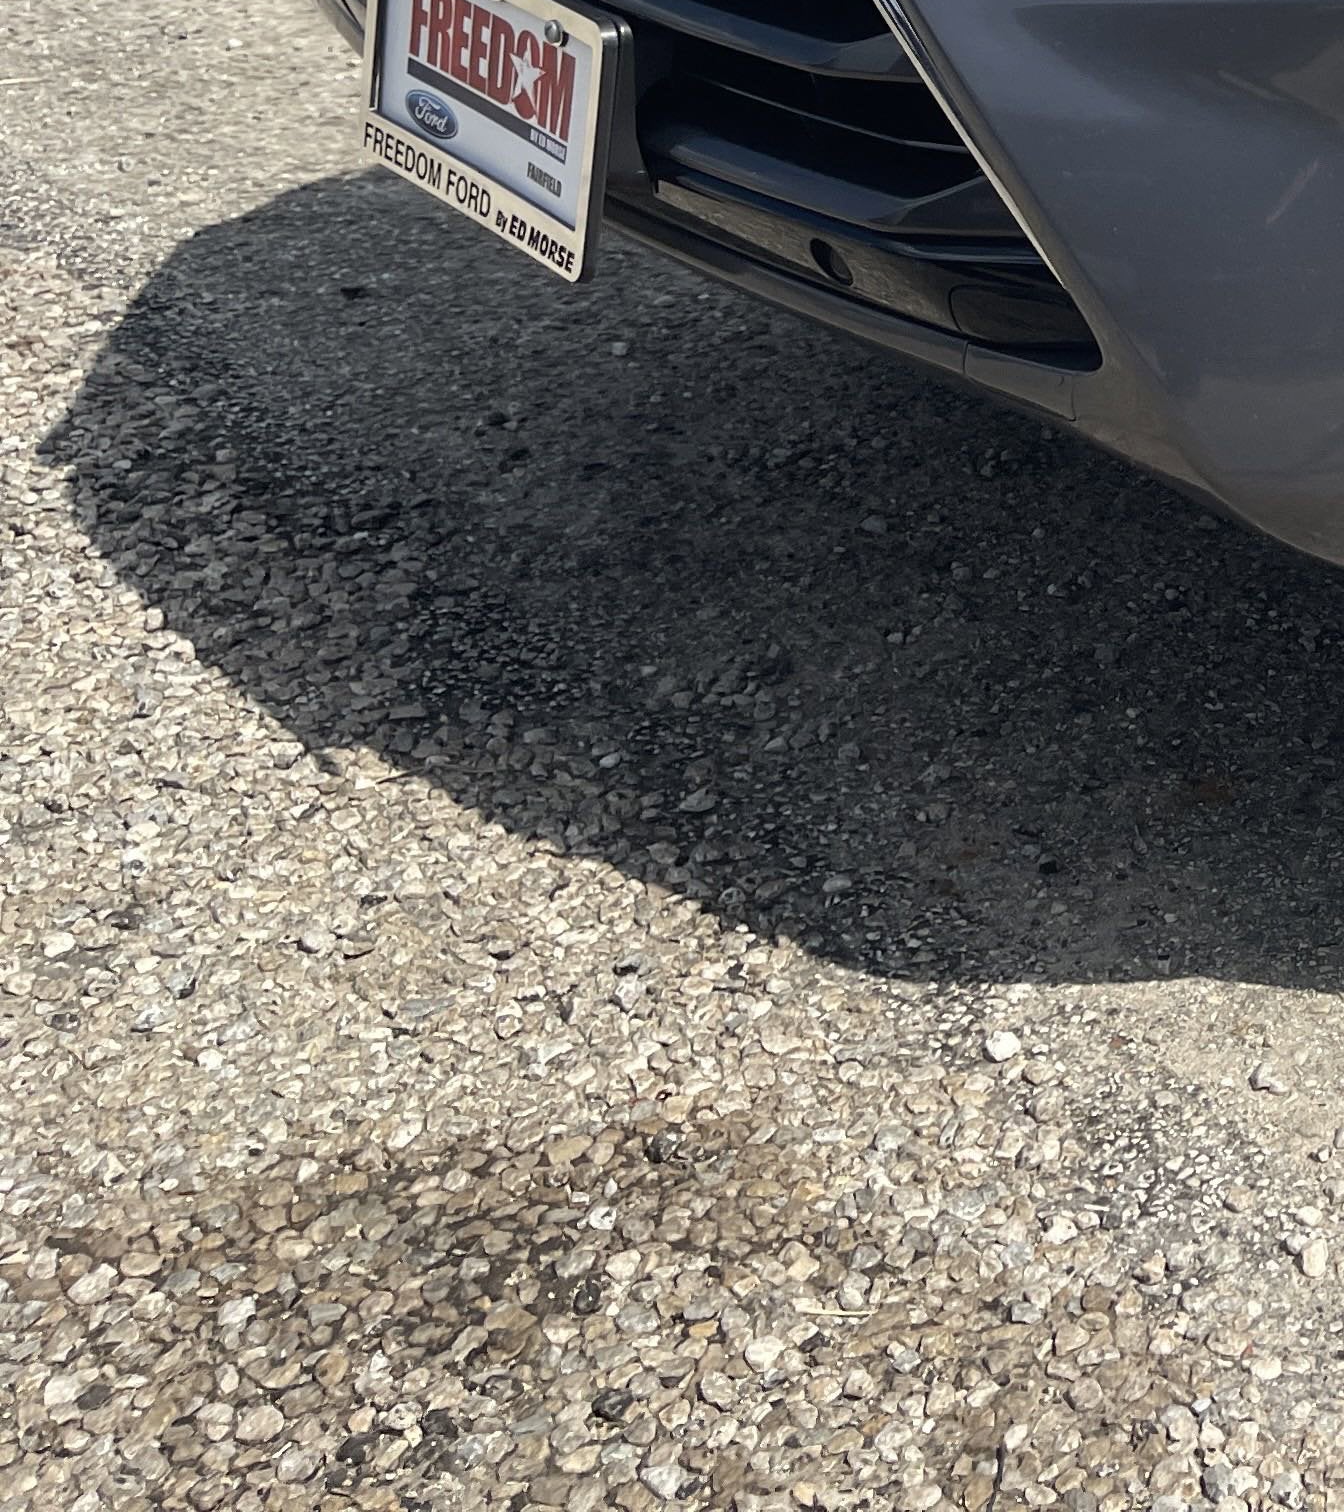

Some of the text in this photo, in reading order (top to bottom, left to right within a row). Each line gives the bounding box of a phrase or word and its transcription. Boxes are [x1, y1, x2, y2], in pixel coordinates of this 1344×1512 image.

[414, 95, 449, 133] Ford
[363, 121, 442, 190] FREEDOM
[445, 168, 491, 218] FORD
[509, 214, 527, 242] ED
[527, 226, 575, 274] MORSE
